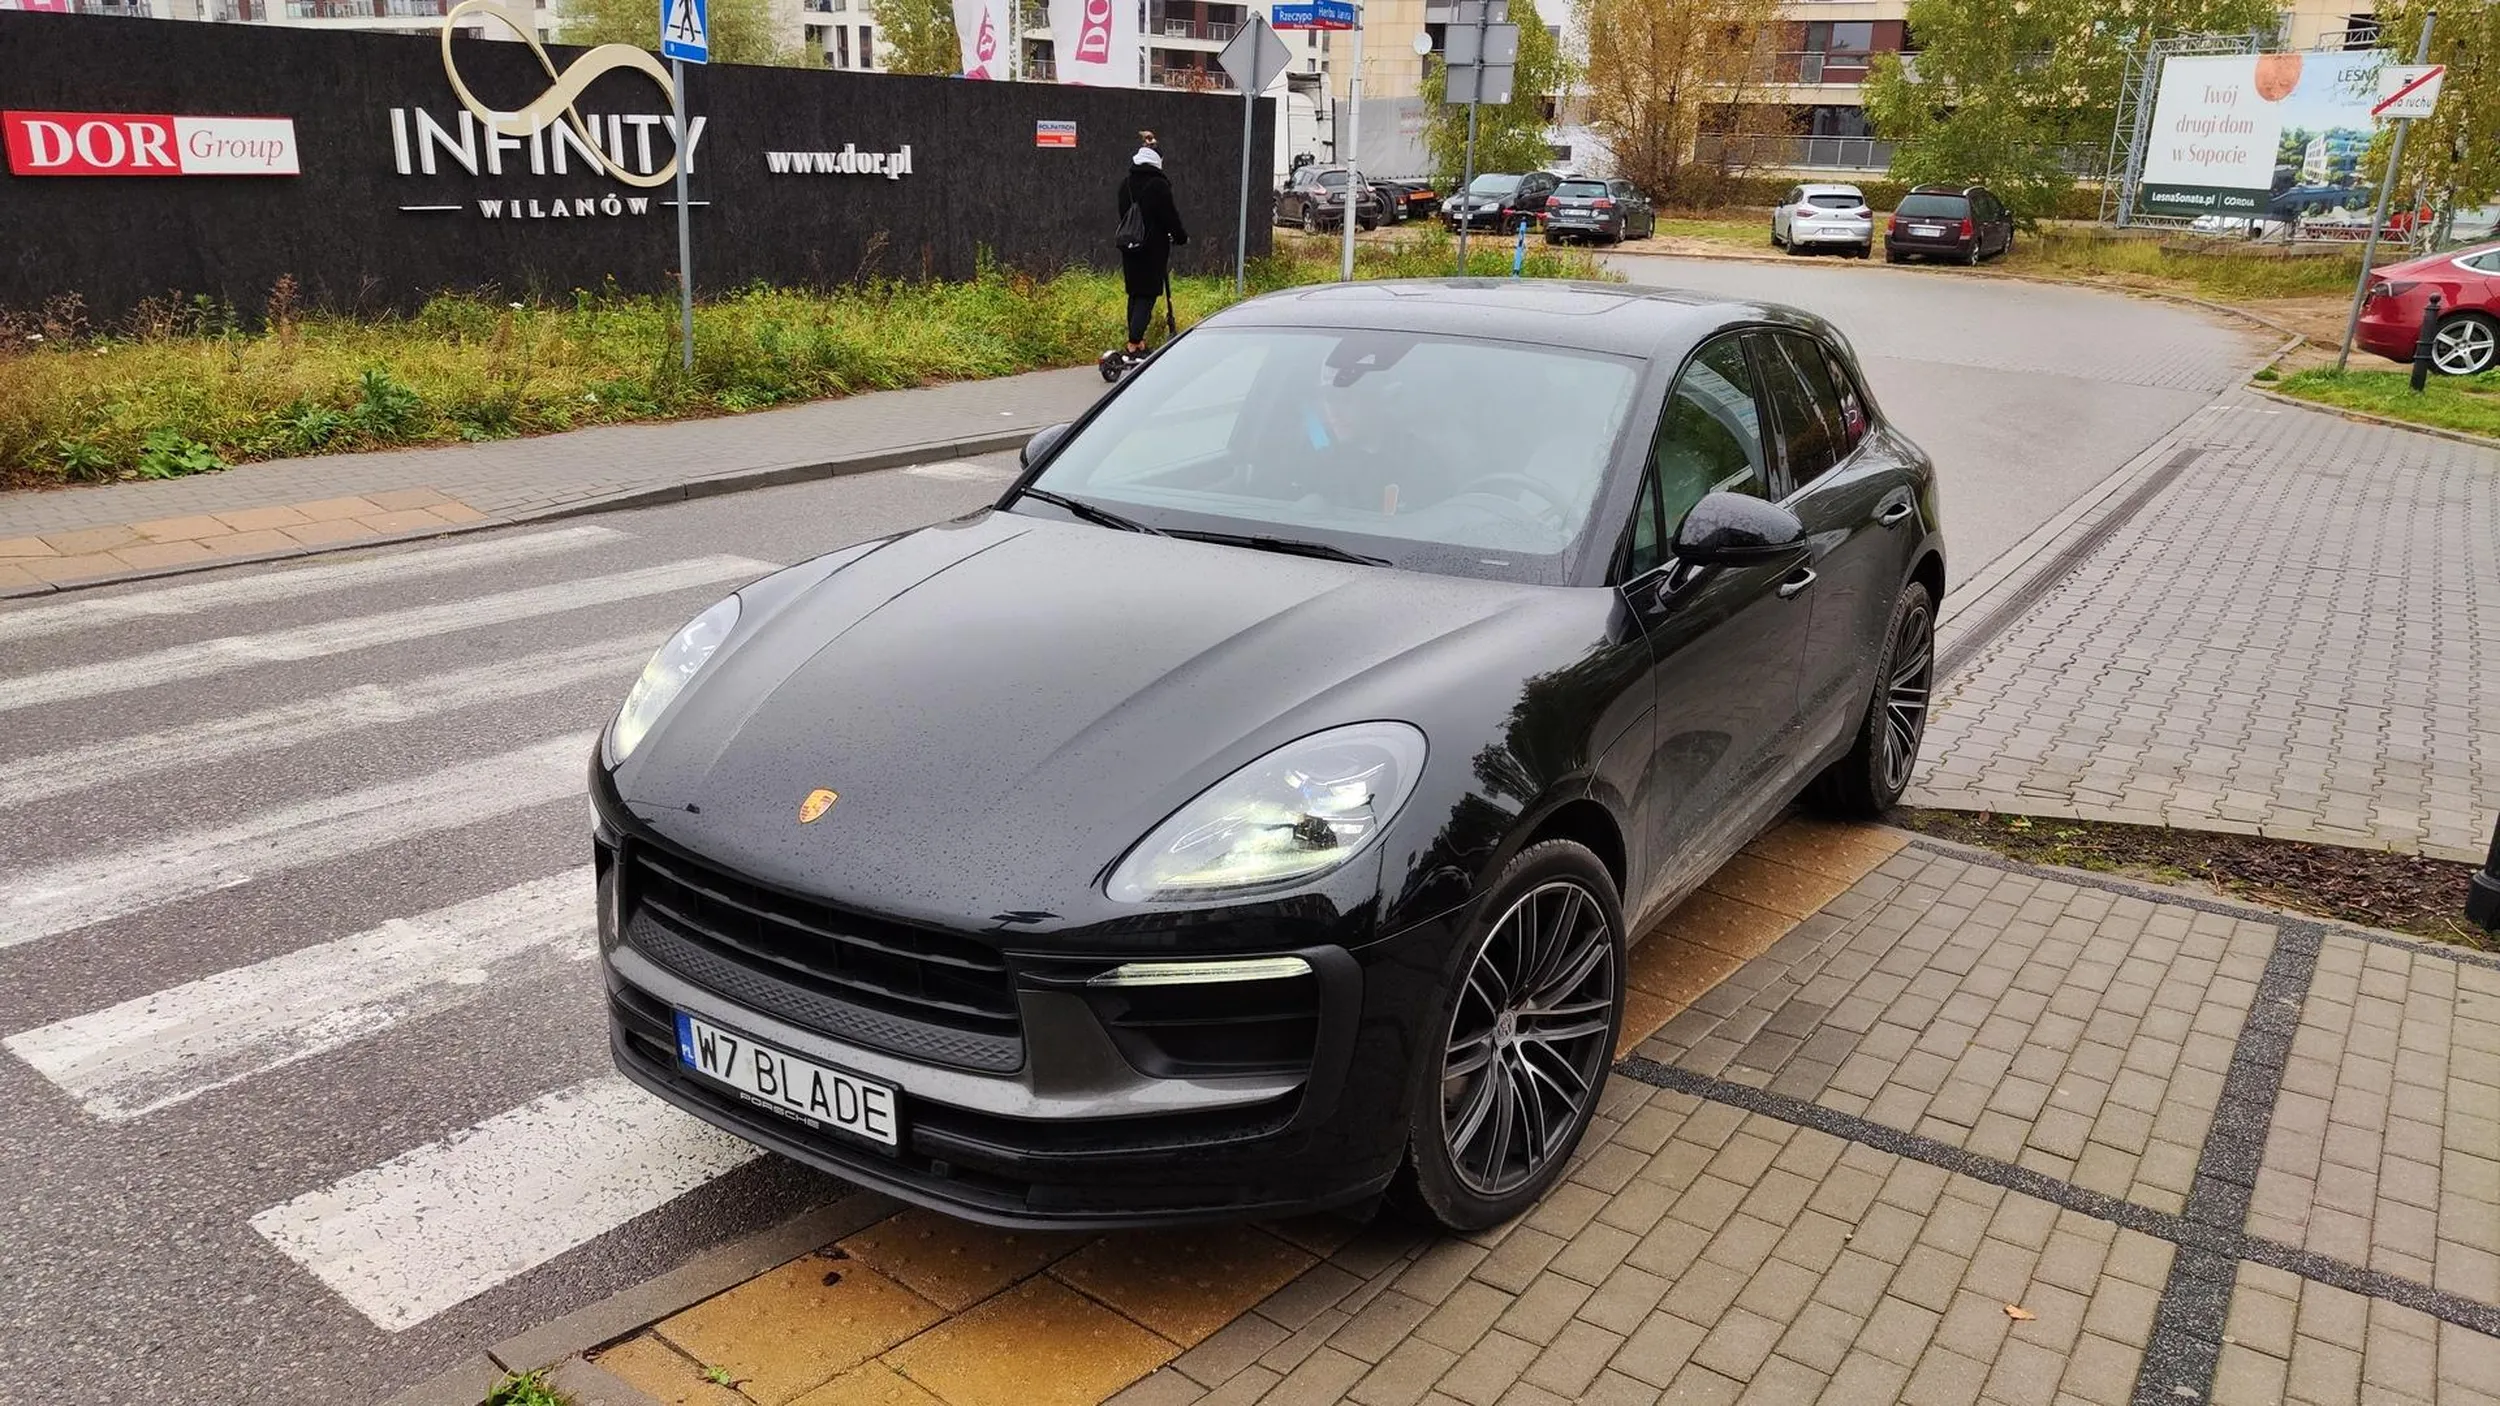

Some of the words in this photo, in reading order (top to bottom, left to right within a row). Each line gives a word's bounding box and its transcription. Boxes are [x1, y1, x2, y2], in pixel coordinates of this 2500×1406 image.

[2204, 84, 2239, 106] Twój
[390, 107, 707, 176] INFINITY
[2175, 114, 2217, 138] drugi
[2218, 114, 2254, 134] dom
[20, 120, 177, 168] DOR
[189, 130, 284, 166] Group
[2172, 148, 2184, 161] w
[2187, 143, 2247, 167] Sopocie
[765, 143, 913, 180] www.dor.pl
[477, 193, 650, 218] WILANÓW
[2151, 191, 2216, 206] LesnaSonata.pl
[696, 1025, 737, 1079] W7
[754, 1048, 888, 1137] BLADE
[740, 1091, 820, 1130] PORSCHE
